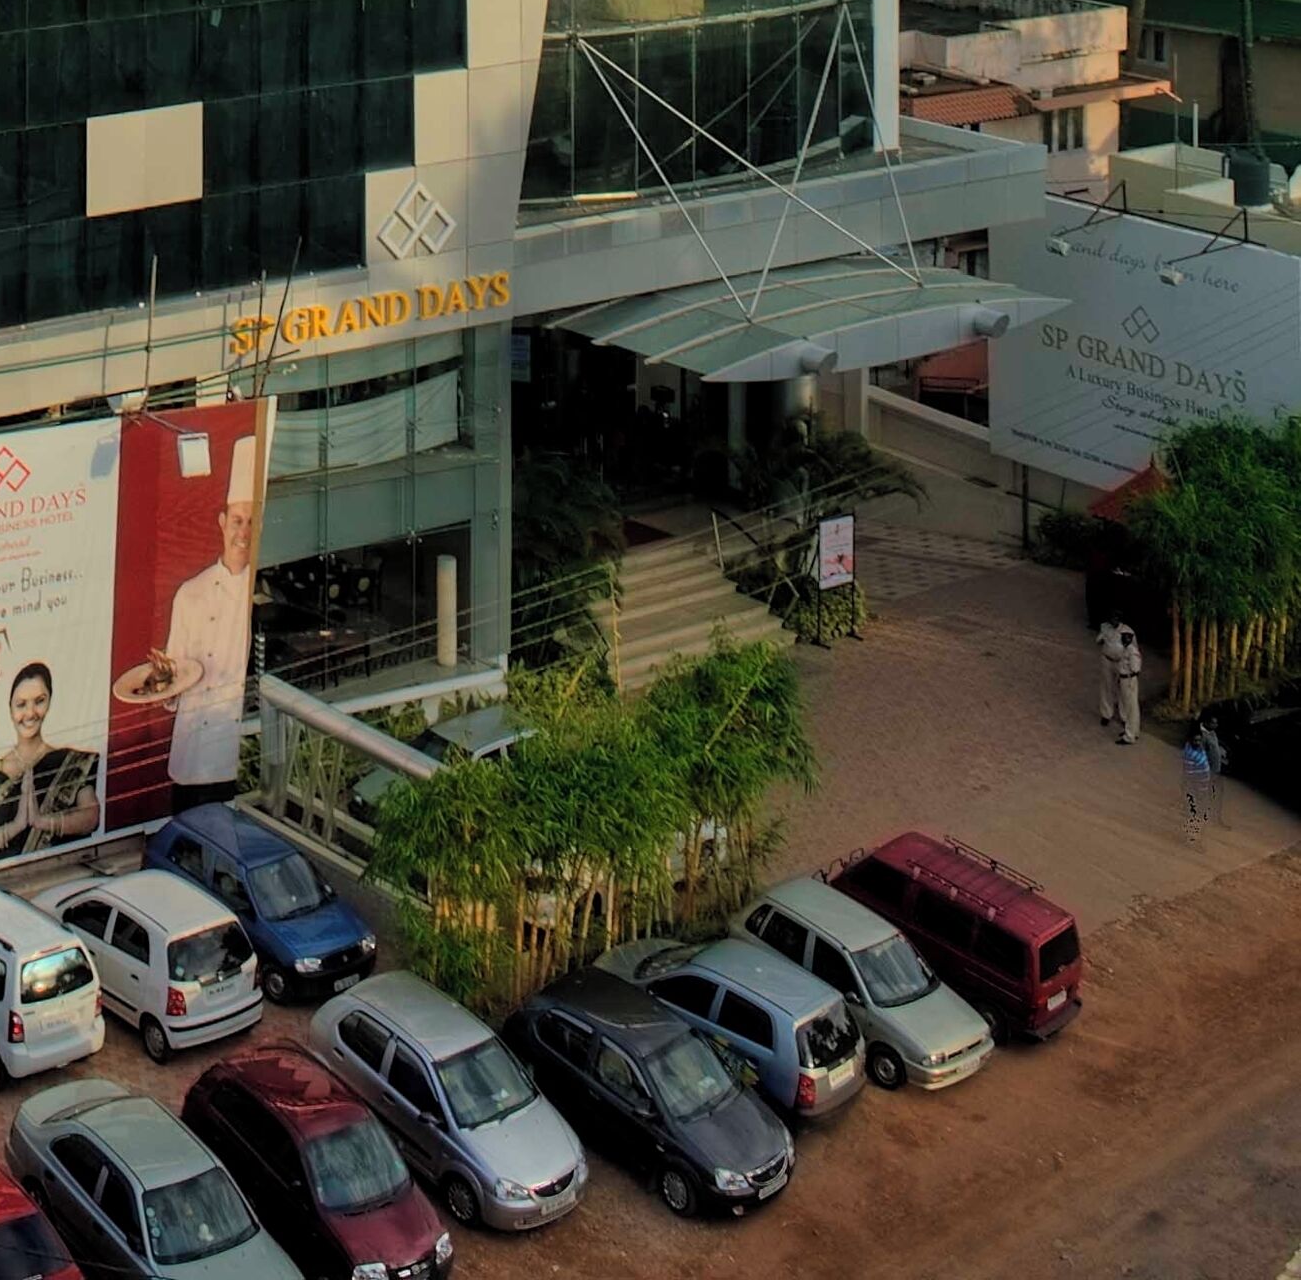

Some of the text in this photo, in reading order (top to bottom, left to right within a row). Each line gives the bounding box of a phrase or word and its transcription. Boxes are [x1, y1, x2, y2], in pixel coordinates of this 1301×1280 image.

[1109, 244, 1146, 275] days
[1202, 267, 1240, 293] here
[282, 290, 412, 345] GRAND
[417, 271, 511, 321] DAYS
[1041, 323, 1247, 403] SP GRAND DAYS
[1065, 365, 1221, 420] A Luxury Business Hotel
[31, 488, 87, 514] DAYS
[40, 511, 74, 526] HOTEL
[12, 590, 42, 616] mind
[47, 596, 68, 613] you
